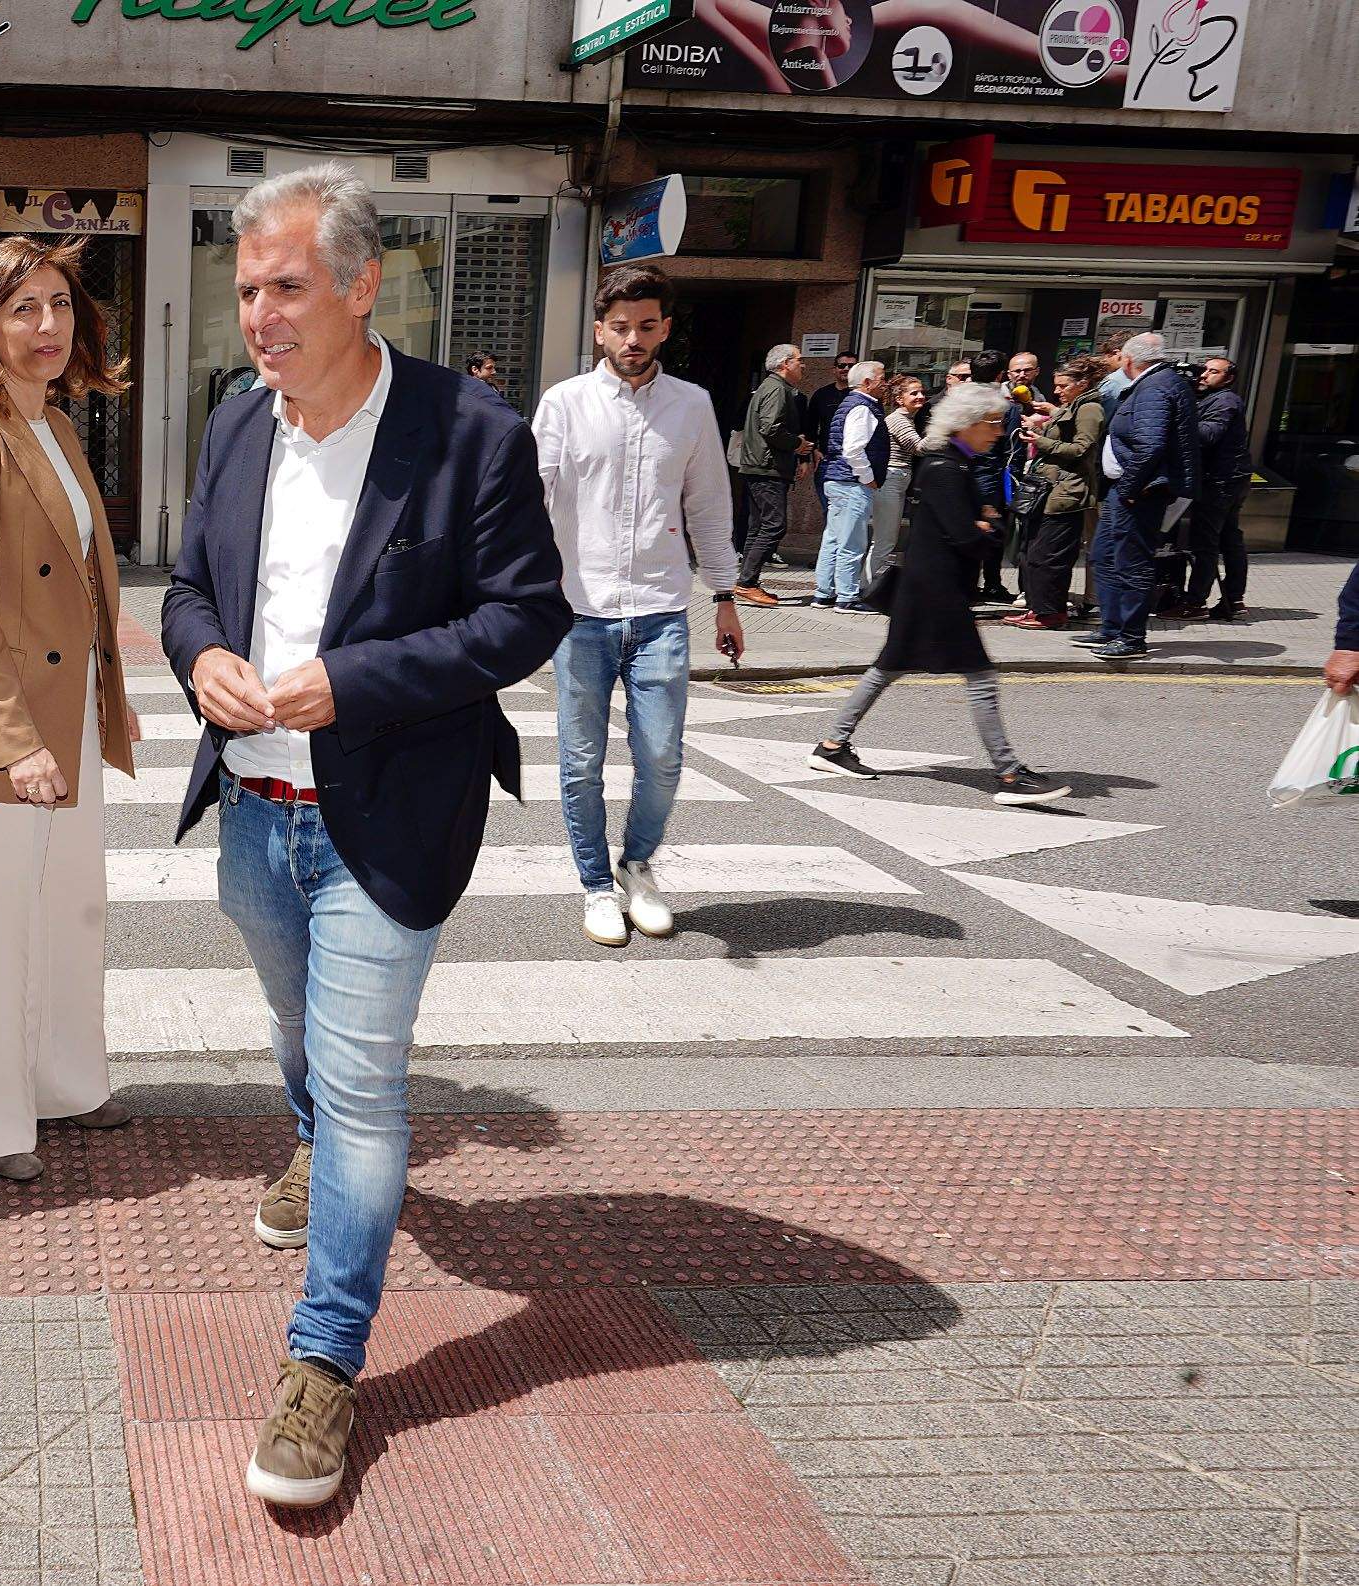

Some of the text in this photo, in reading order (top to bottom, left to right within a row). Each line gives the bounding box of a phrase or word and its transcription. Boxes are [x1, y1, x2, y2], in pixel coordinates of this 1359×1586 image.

[775, 3, 834, 17] Antiarrugas
[574, 3, 667, 58] CENTRO DE ESTÉTICA
[641, 64, 707, 77] Cell Therapy
[781, 58, 827, 71] Anti-edad
[1104, 191, 1260, 226] TABACOS
[1100, 302, 1143, 315] BOTES
